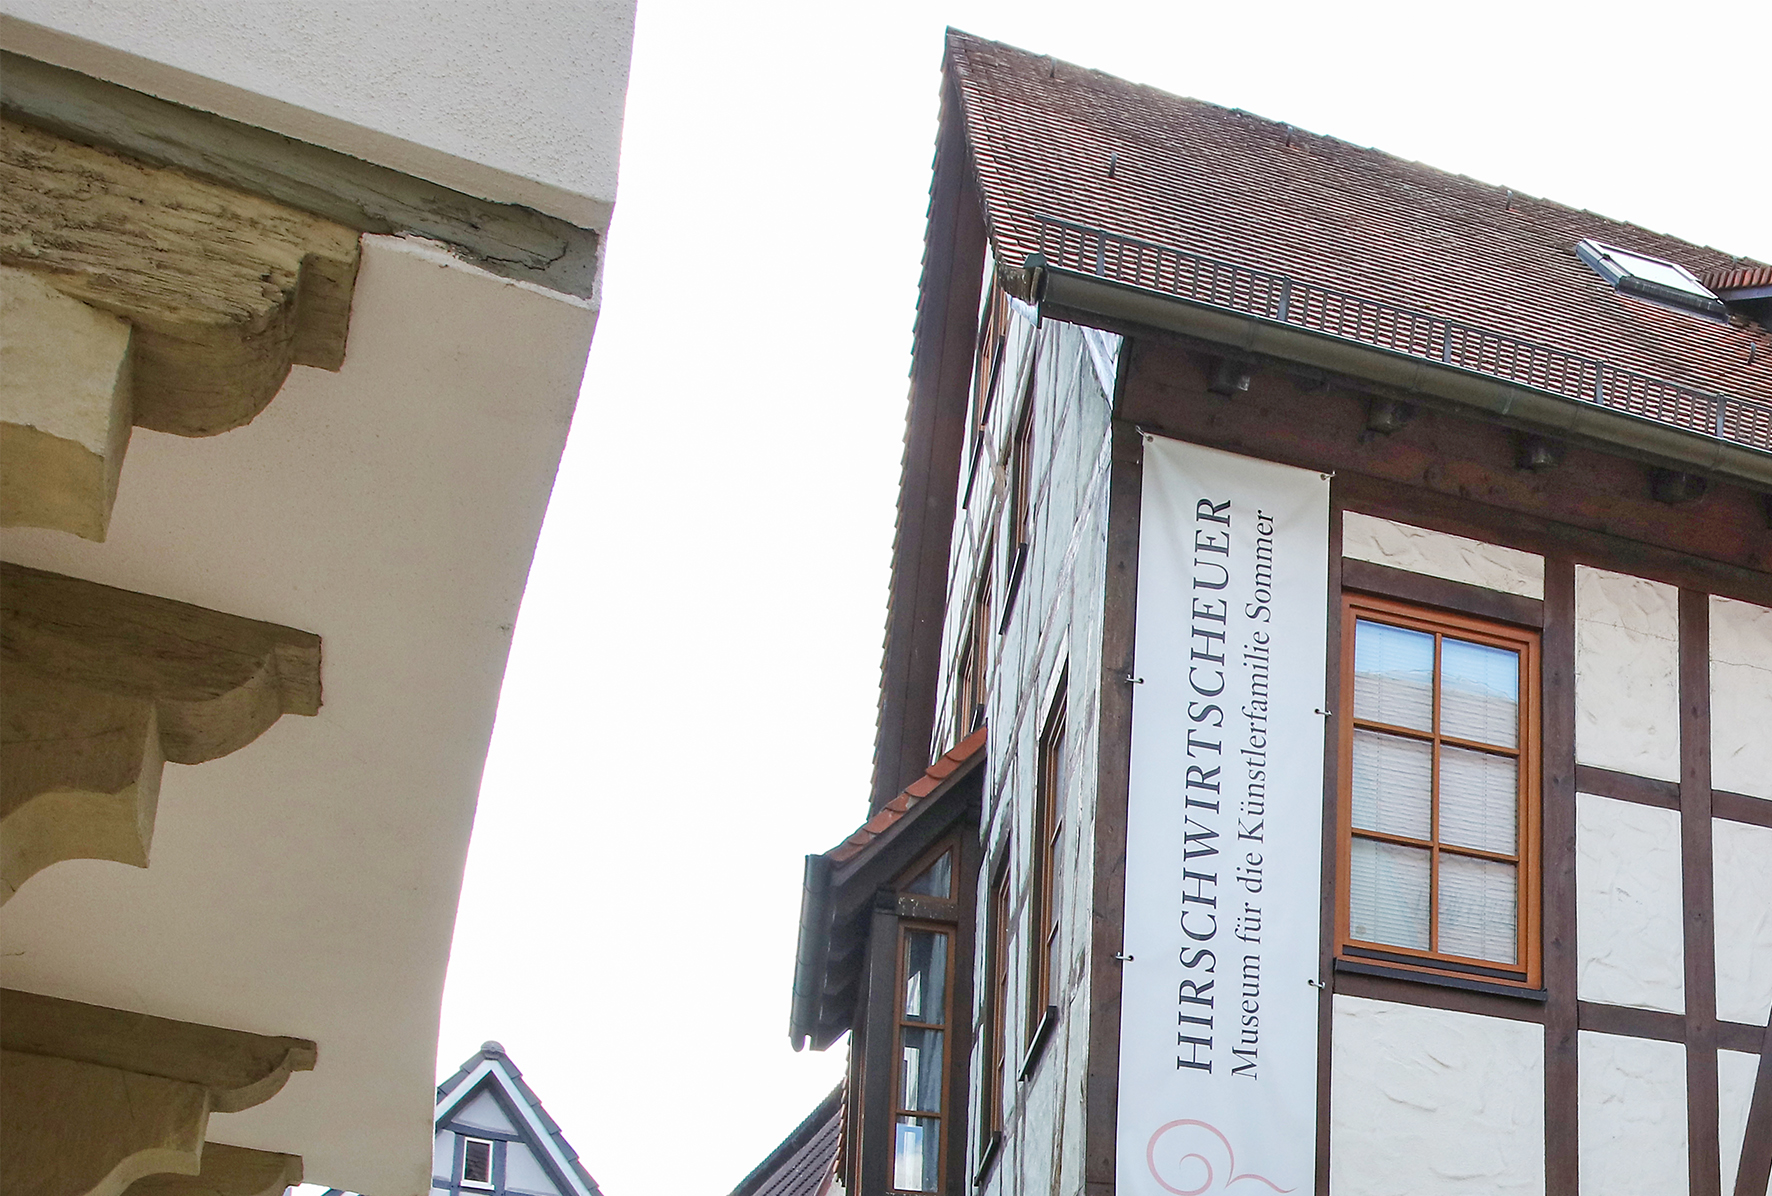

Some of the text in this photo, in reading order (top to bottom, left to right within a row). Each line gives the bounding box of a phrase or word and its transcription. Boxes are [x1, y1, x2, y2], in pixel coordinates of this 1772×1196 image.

[1176, 498, 1231, 1075] HIRSCHWIRTSCHEUER
[1231, 509, 1274, 1080] Museum für die Künstlerfamilie Sommer
